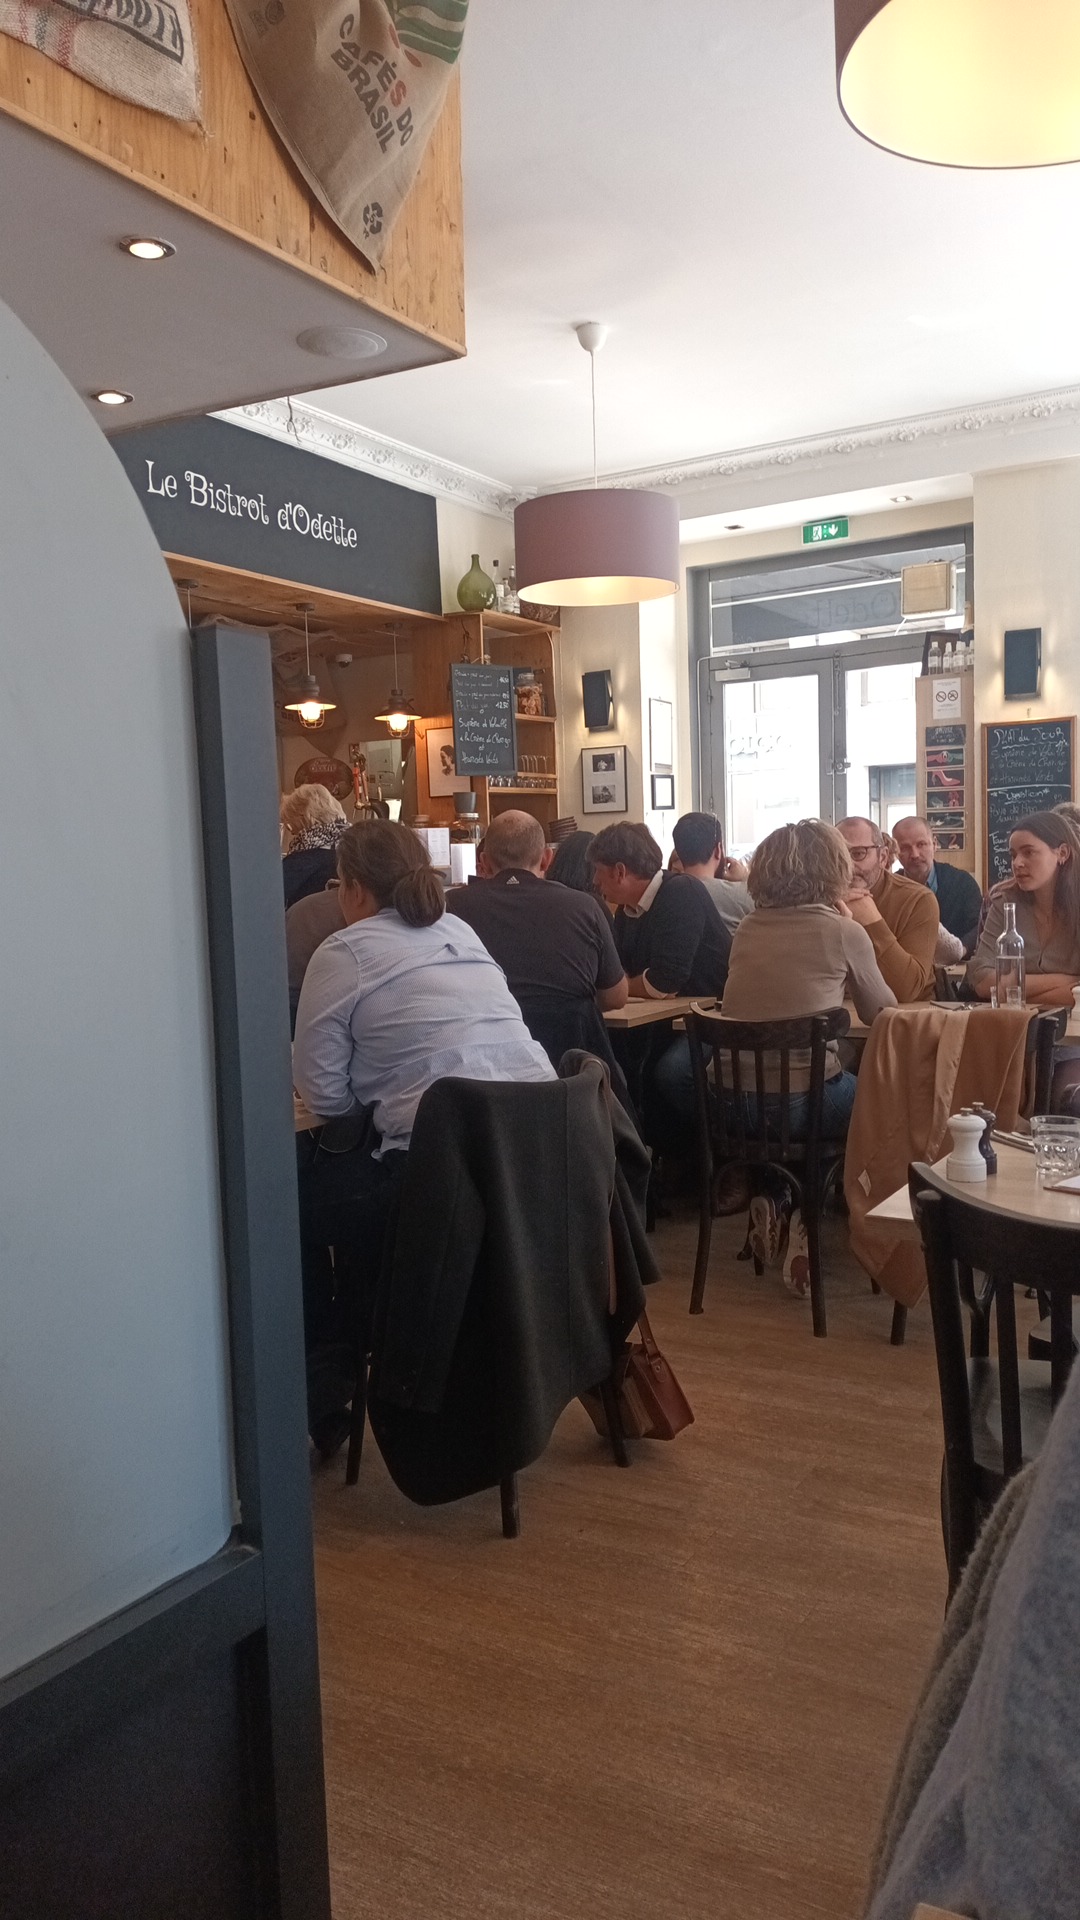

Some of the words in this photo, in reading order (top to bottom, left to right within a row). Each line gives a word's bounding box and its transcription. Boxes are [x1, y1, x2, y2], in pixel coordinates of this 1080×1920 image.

[330, 47, 396, 154] BRASIL
[396, 106, 414, 147] DO
[145, 459, 178, 498] Le
[184, 470, 270, 525] Bistrot
[277, 501, 358, 548] d'Odette
[1018, 729, 1030, 742] du
